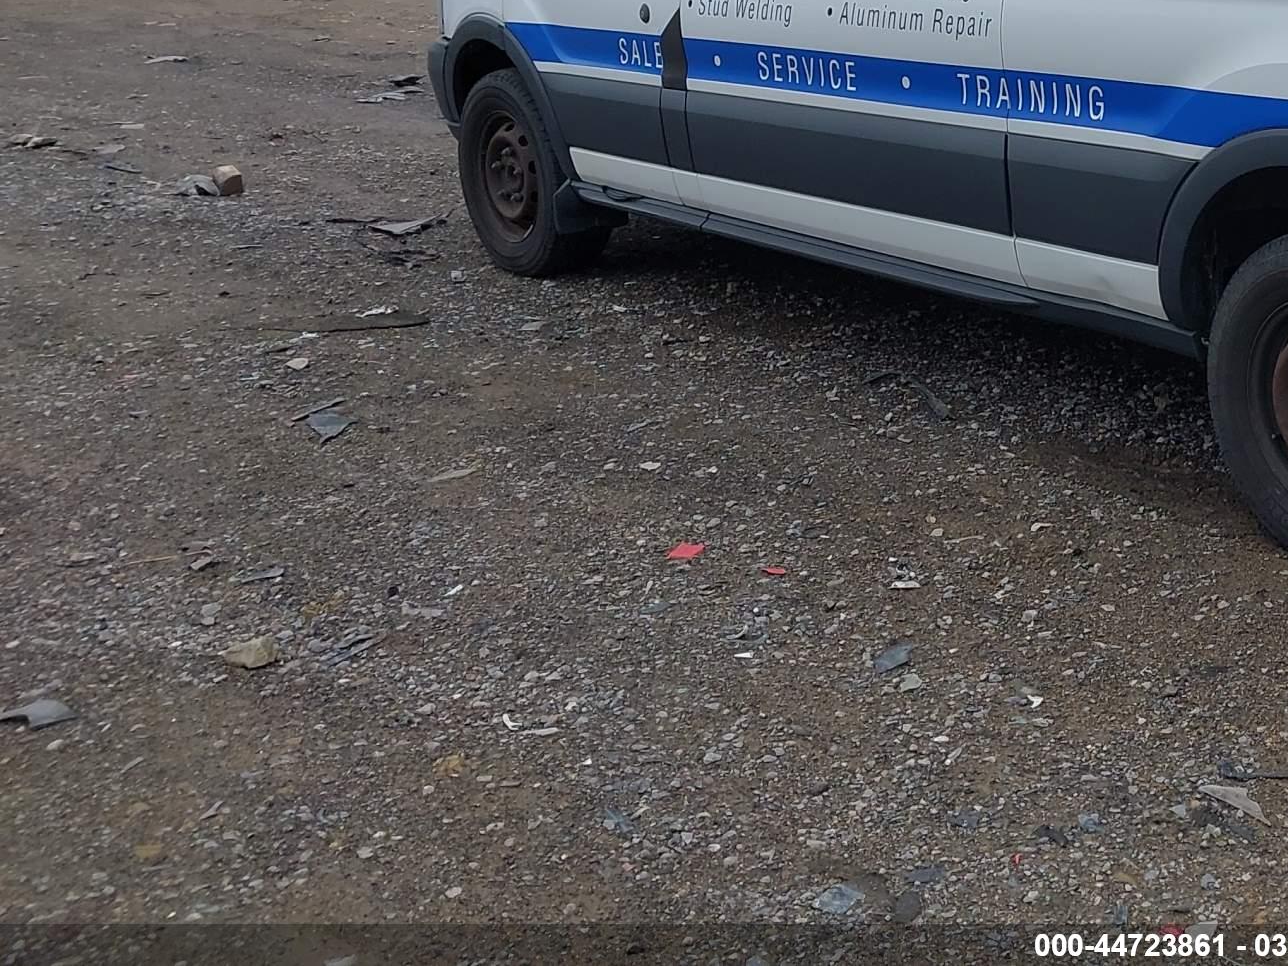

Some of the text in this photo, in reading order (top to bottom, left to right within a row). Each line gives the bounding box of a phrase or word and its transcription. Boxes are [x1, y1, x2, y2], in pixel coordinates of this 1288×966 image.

[839, 2, 993, 41] Aluminum Repair
[758, 52, 857, 92] SERVICE
[956, 72, 1105, 121] TRAINING
